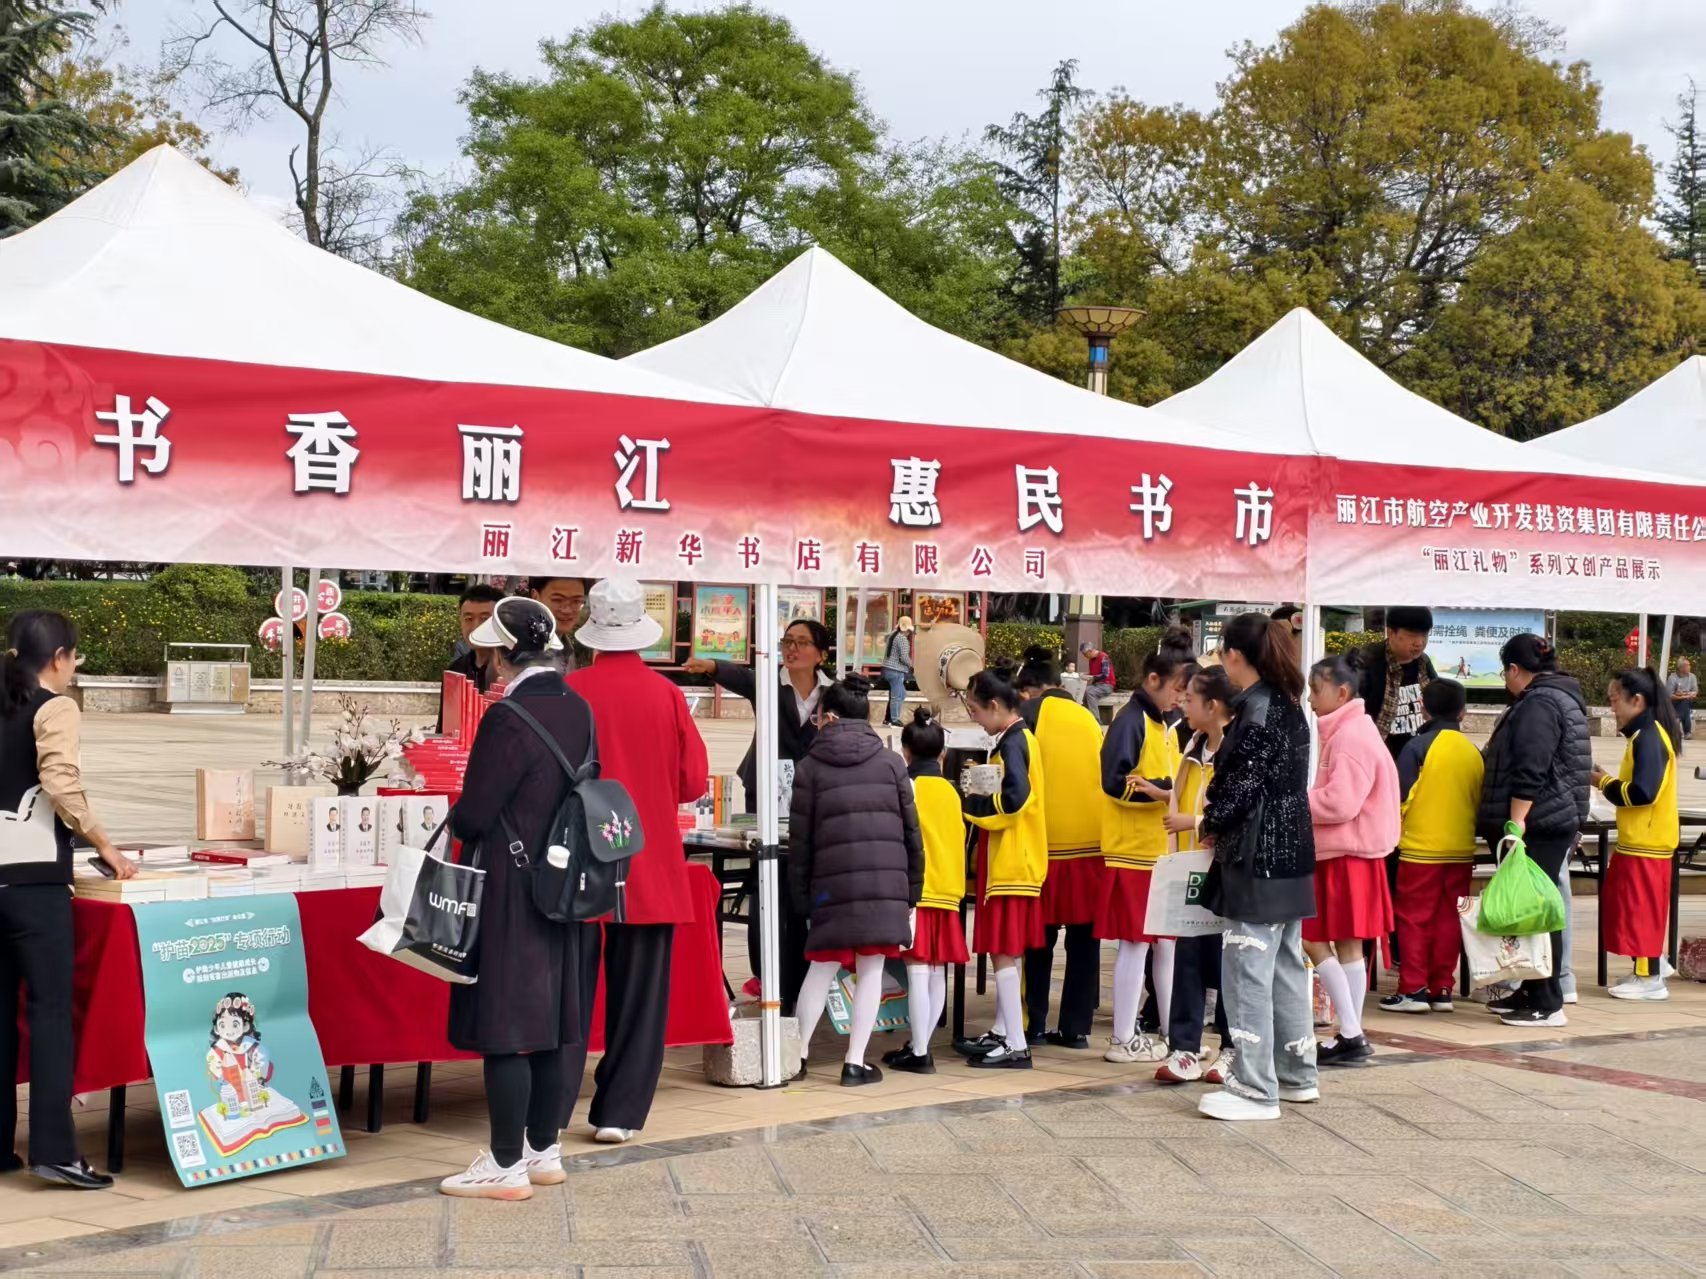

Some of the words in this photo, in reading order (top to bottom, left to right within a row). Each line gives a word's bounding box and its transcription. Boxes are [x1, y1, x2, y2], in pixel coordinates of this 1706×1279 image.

[94, 394, 671, 511] 书香丽江
[888, 456, 1275, 546] 惠民书市
[482, 522, 1048, 579] 丽江新华书店有限公司
